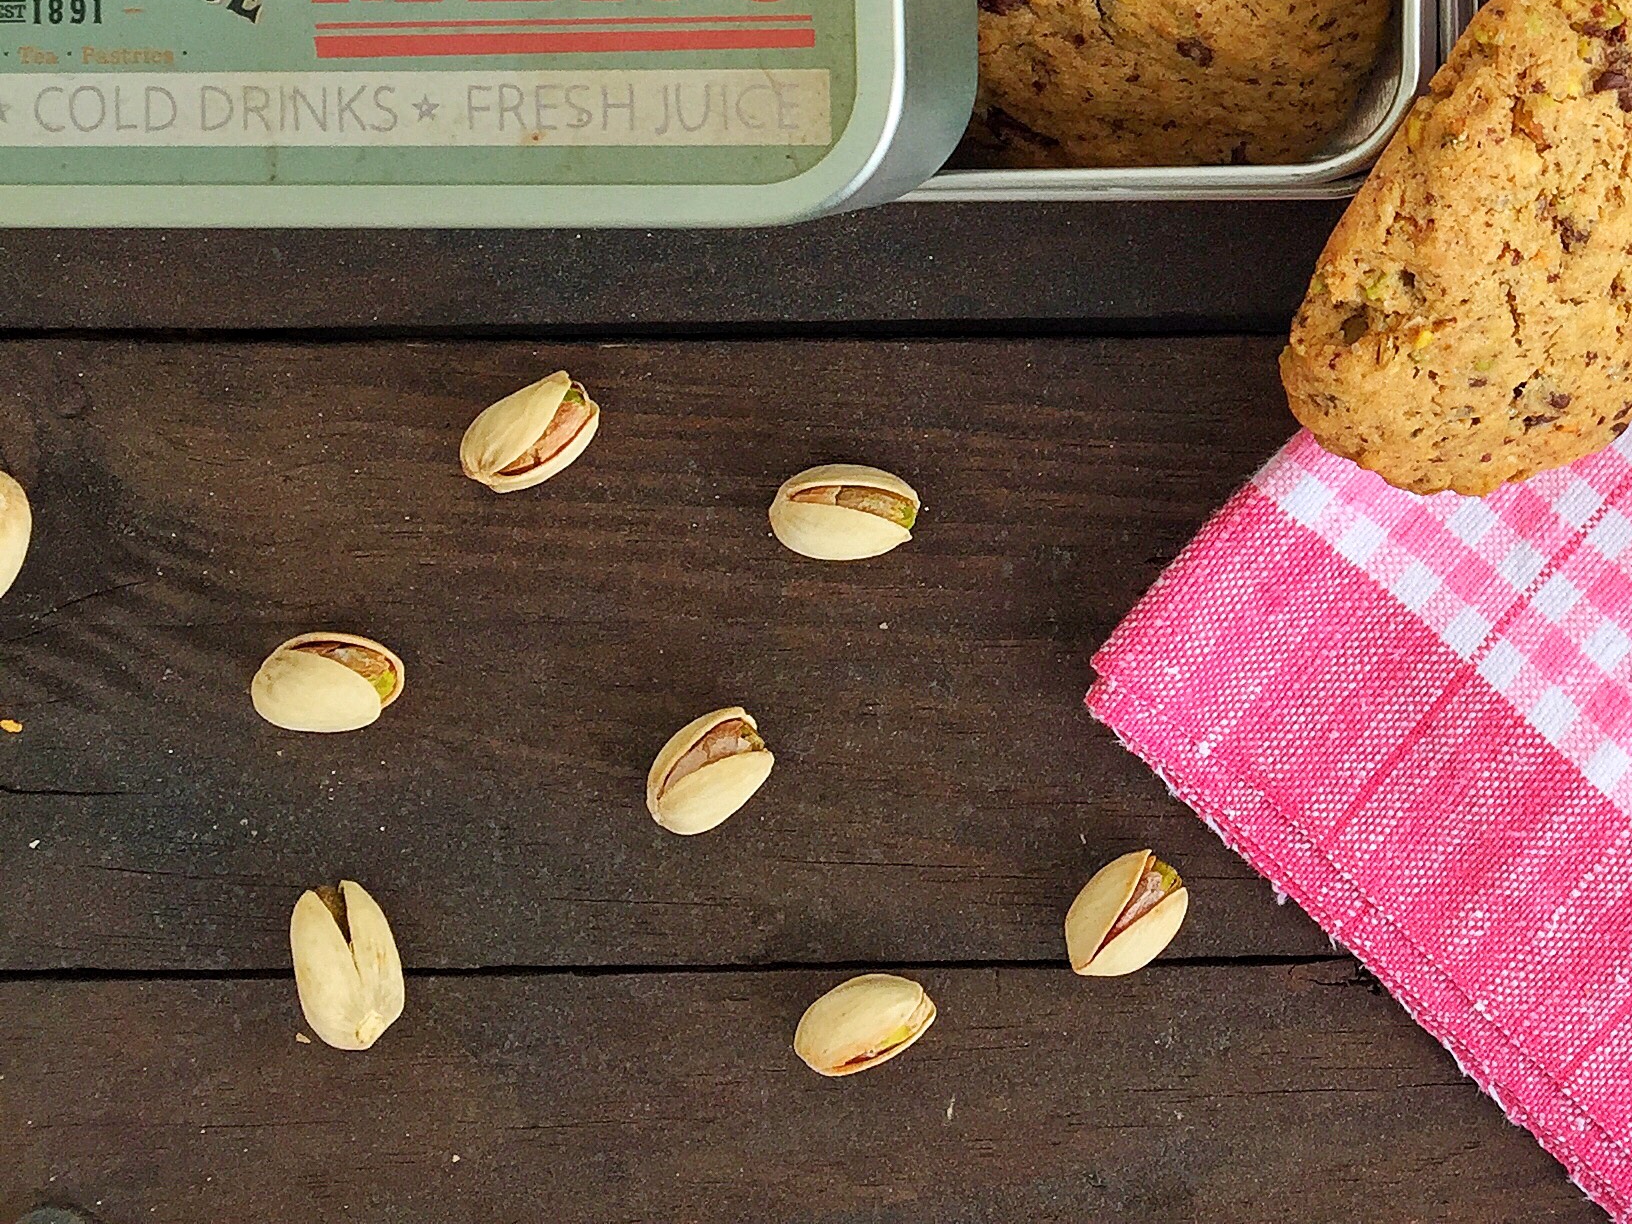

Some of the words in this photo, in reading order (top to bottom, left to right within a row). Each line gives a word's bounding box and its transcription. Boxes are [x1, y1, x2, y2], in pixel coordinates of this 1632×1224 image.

[18, 45, 59, 65] Tea
[81, 45, 175, 65] Pastries
[34, 84, 178, 133] COLD
[200, 83, 399, 134] DRINKS
[466, 82, 636, 132] FRESH
[655, 81, 802, 132] JUICE
